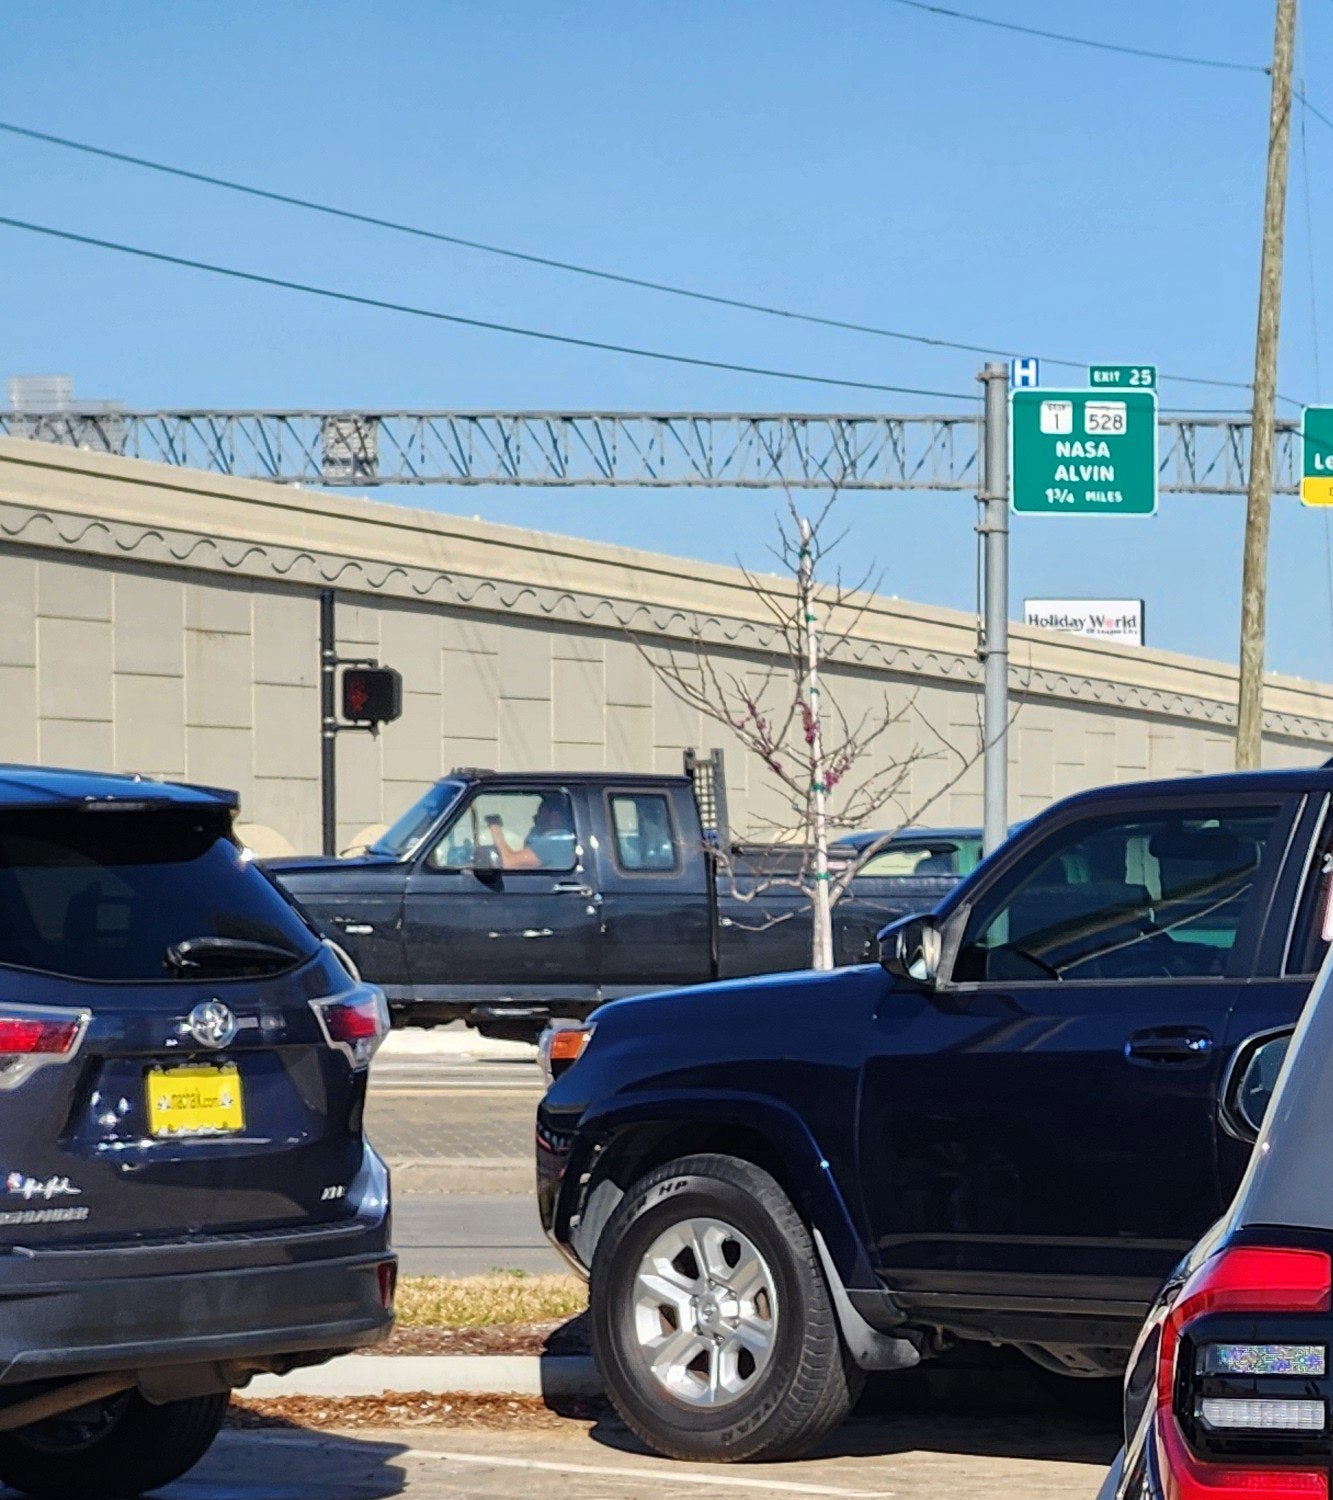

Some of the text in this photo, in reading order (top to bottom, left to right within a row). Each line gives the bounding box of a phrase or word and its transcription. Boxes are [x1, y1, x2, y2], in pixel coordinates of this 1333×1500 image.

[1093, 369, 1151, 385] EXIT 25
[1088, 414, 1123, 431] 528
[1055, 440, 1110, 459] NASA
[1054, 464, 1115, 482] ALVIN
[1085, 490, 1123, 503] MILES
[1028, 613, 1137, 631] Holiday World
[658, 1180, 688, 1196] HP
